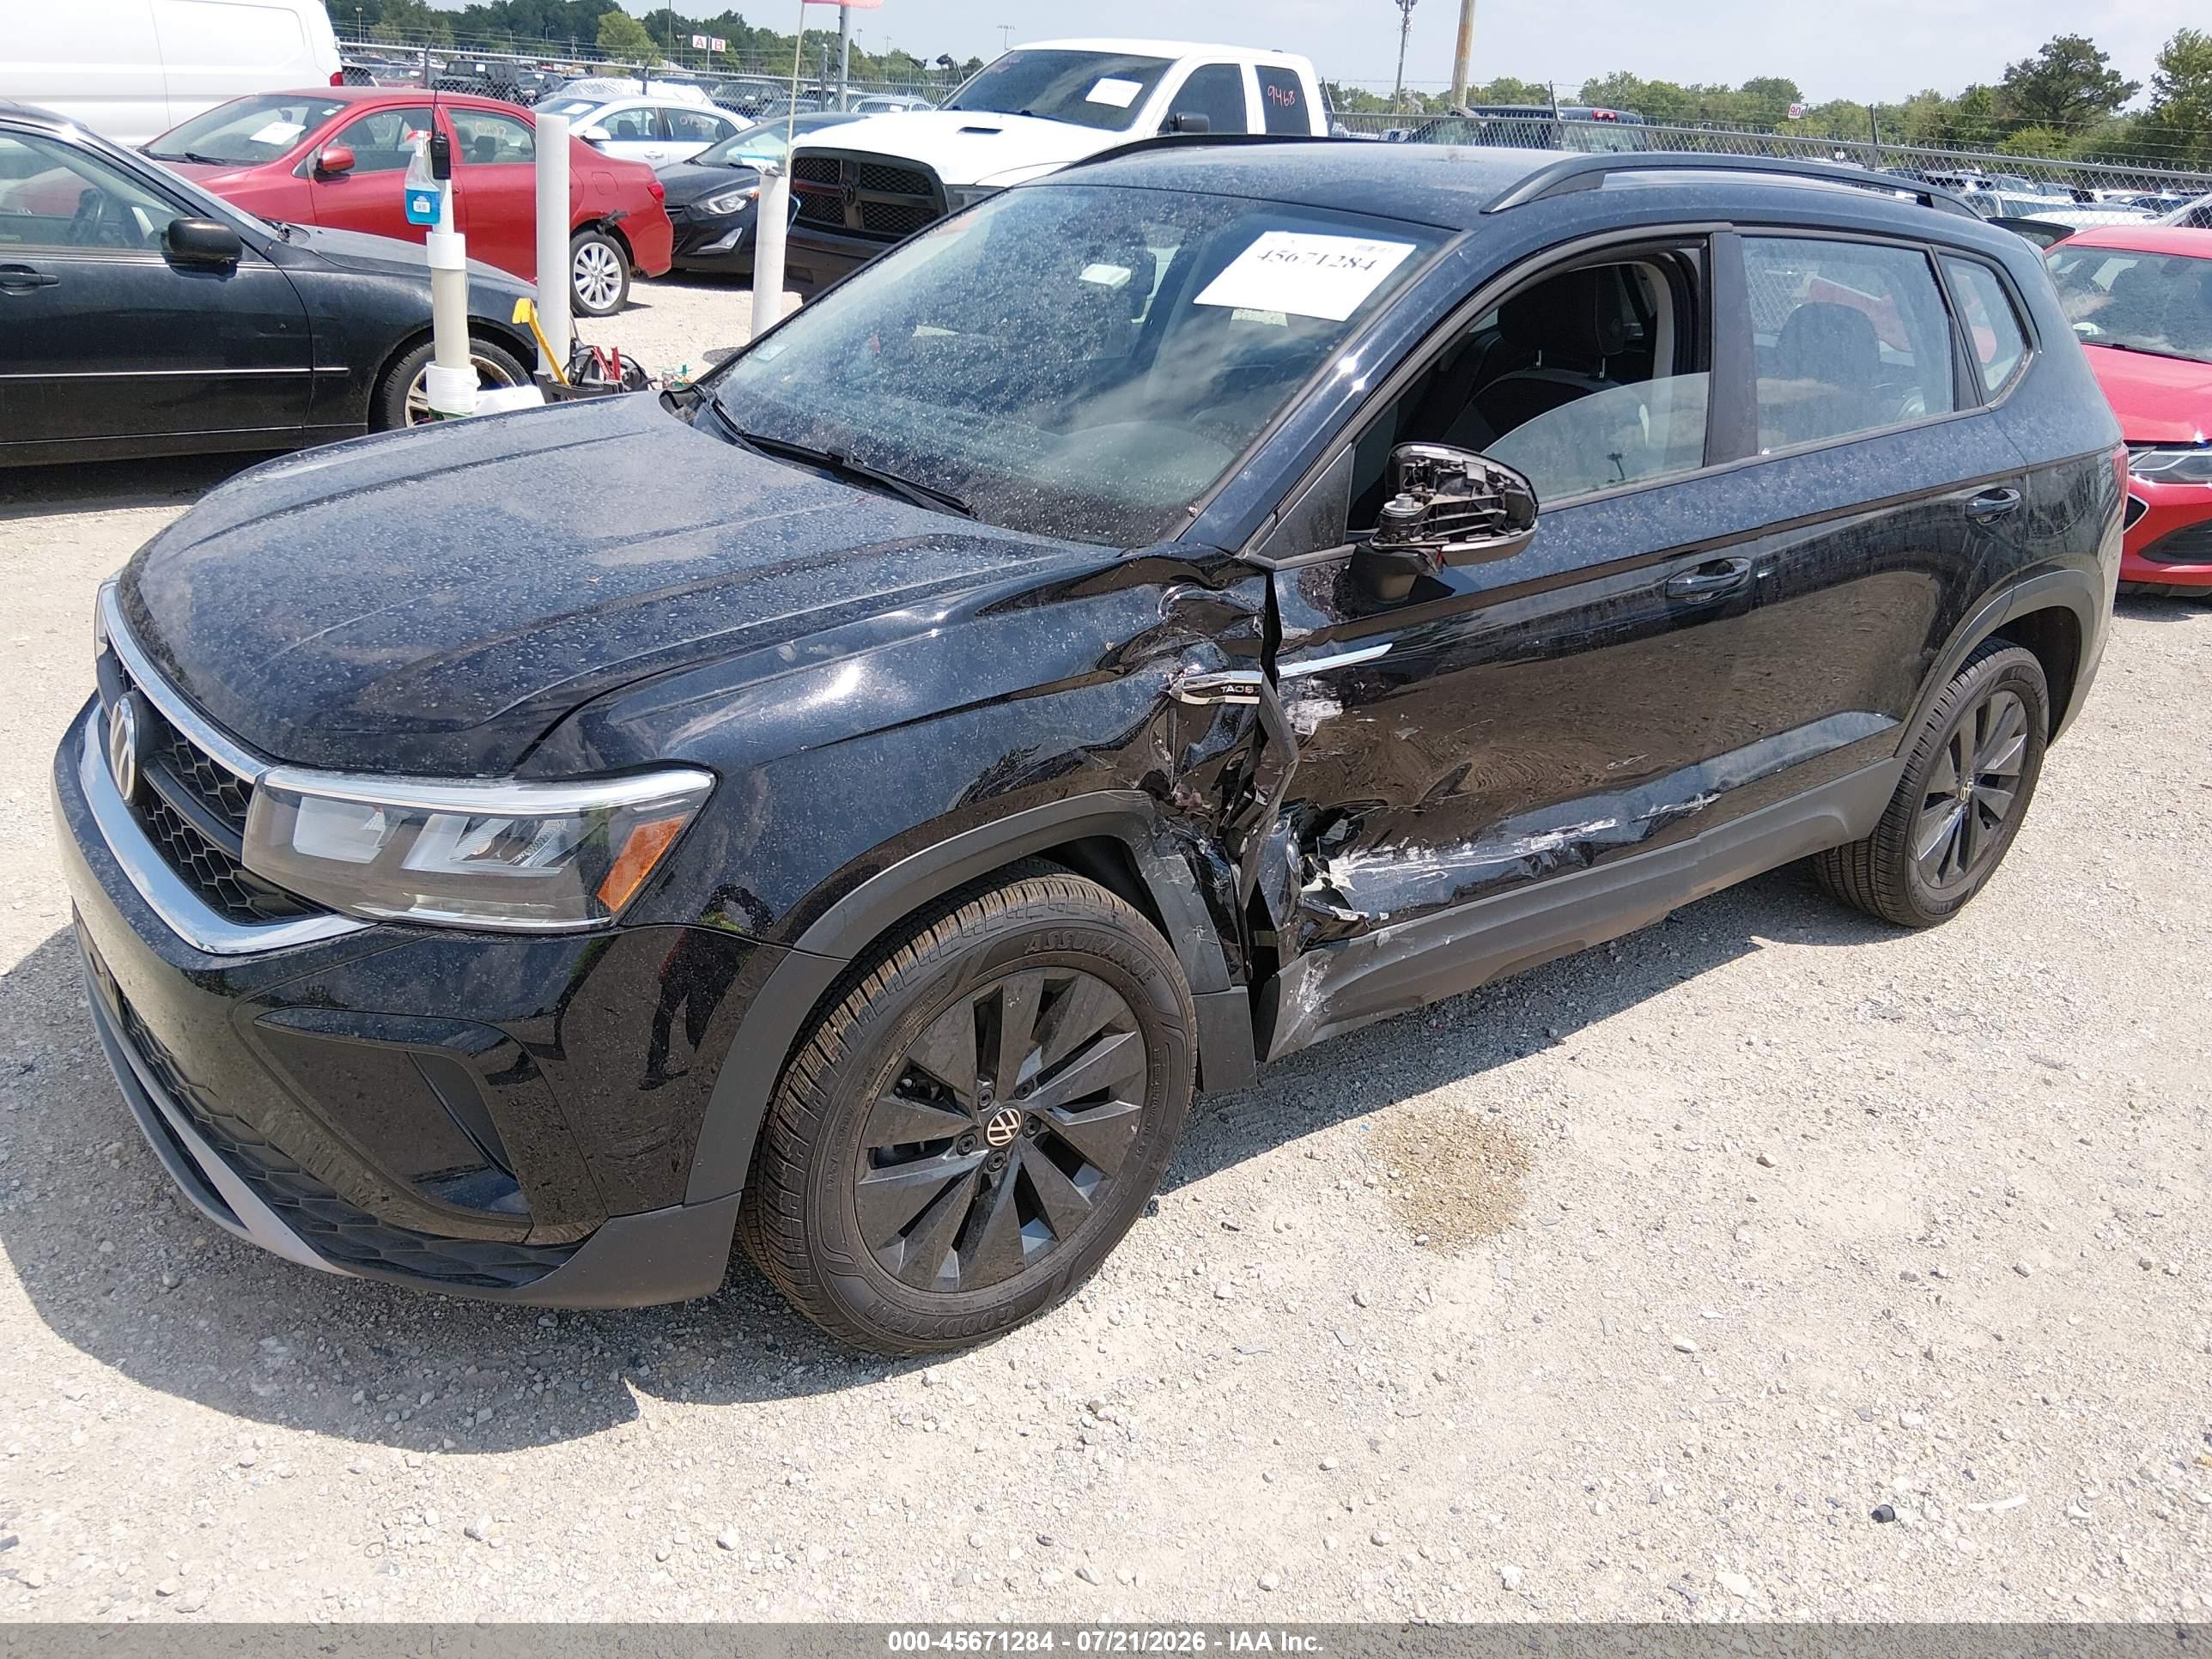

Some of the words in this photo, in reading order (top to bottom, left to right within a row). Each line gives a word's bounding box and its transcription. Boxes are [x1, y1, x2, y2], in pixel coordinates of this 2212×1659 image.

[696, 37, 704, 48] A
[714, 40, 723, 51] B
[1267, 85, 1296, 107] 9468
[1220, 684, 1255, 695] TAOS
[1024, 930, 1158, 986] ASSURANCE
[864, 1300, 1016, 1339] GOODYEAR
